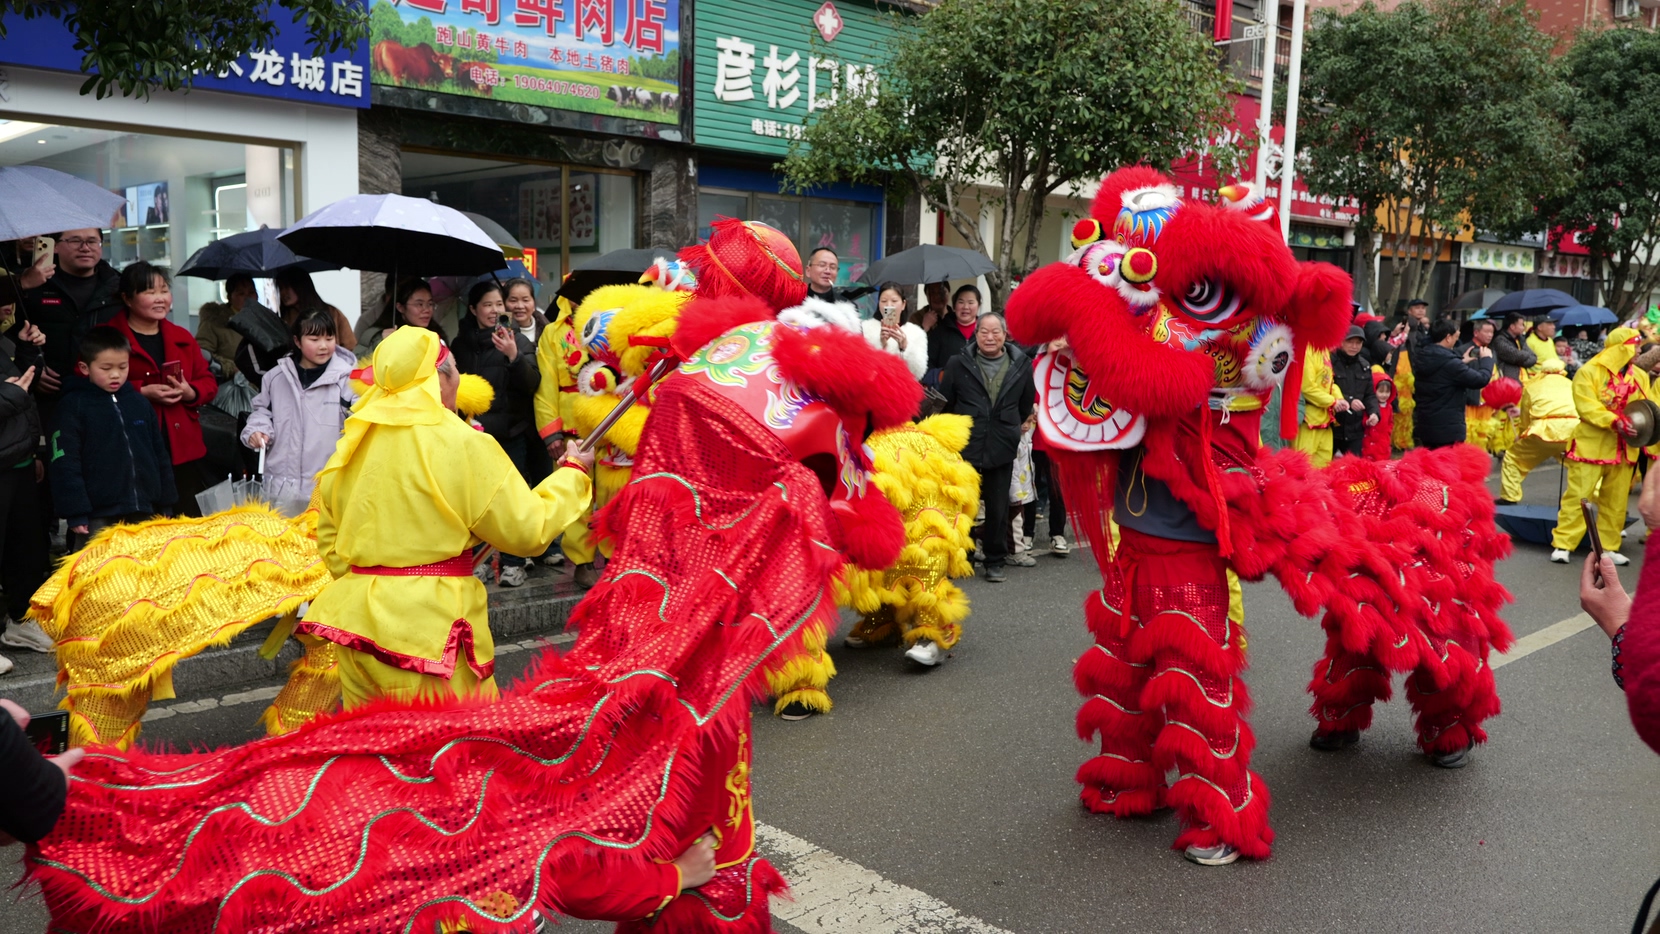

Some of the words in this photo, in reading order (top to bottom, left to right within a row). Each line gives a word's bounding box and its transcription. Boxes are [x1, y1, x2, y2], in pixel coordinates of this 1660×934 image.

[392, 0, 667, 53] 鲜肉店
[435, 26, 528, 59] 跑山黄牛肉
[548, 46, 631, 76] 本地土猪肉
